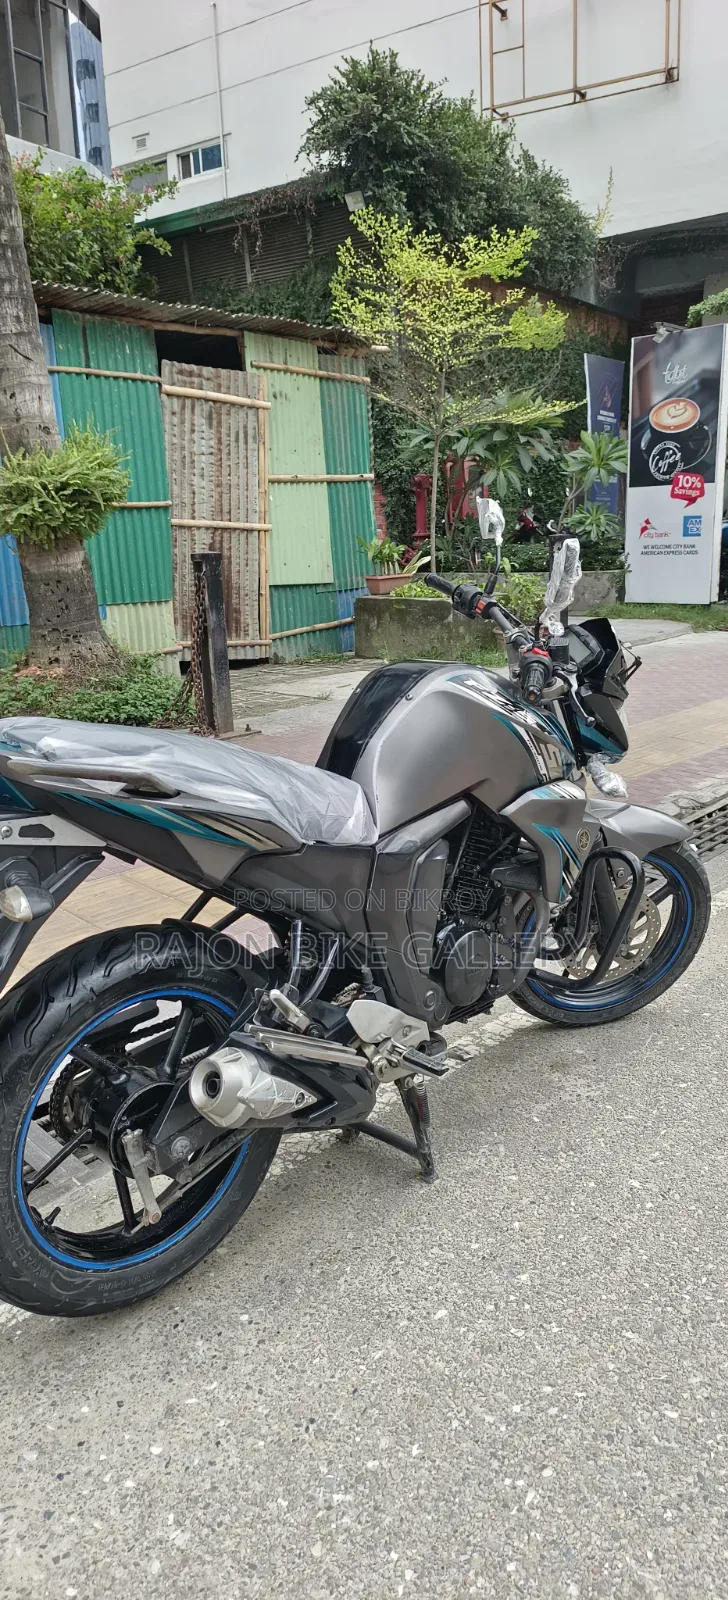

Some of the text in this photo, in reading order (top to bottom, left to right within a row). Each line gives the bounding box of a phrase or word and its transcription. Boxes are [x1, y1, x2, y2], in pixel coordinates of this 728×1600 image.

[651, 449, 682, 473] Coffee
[678, 475, 702, 488] 10%
[673, 487, 700, 498] Savings
